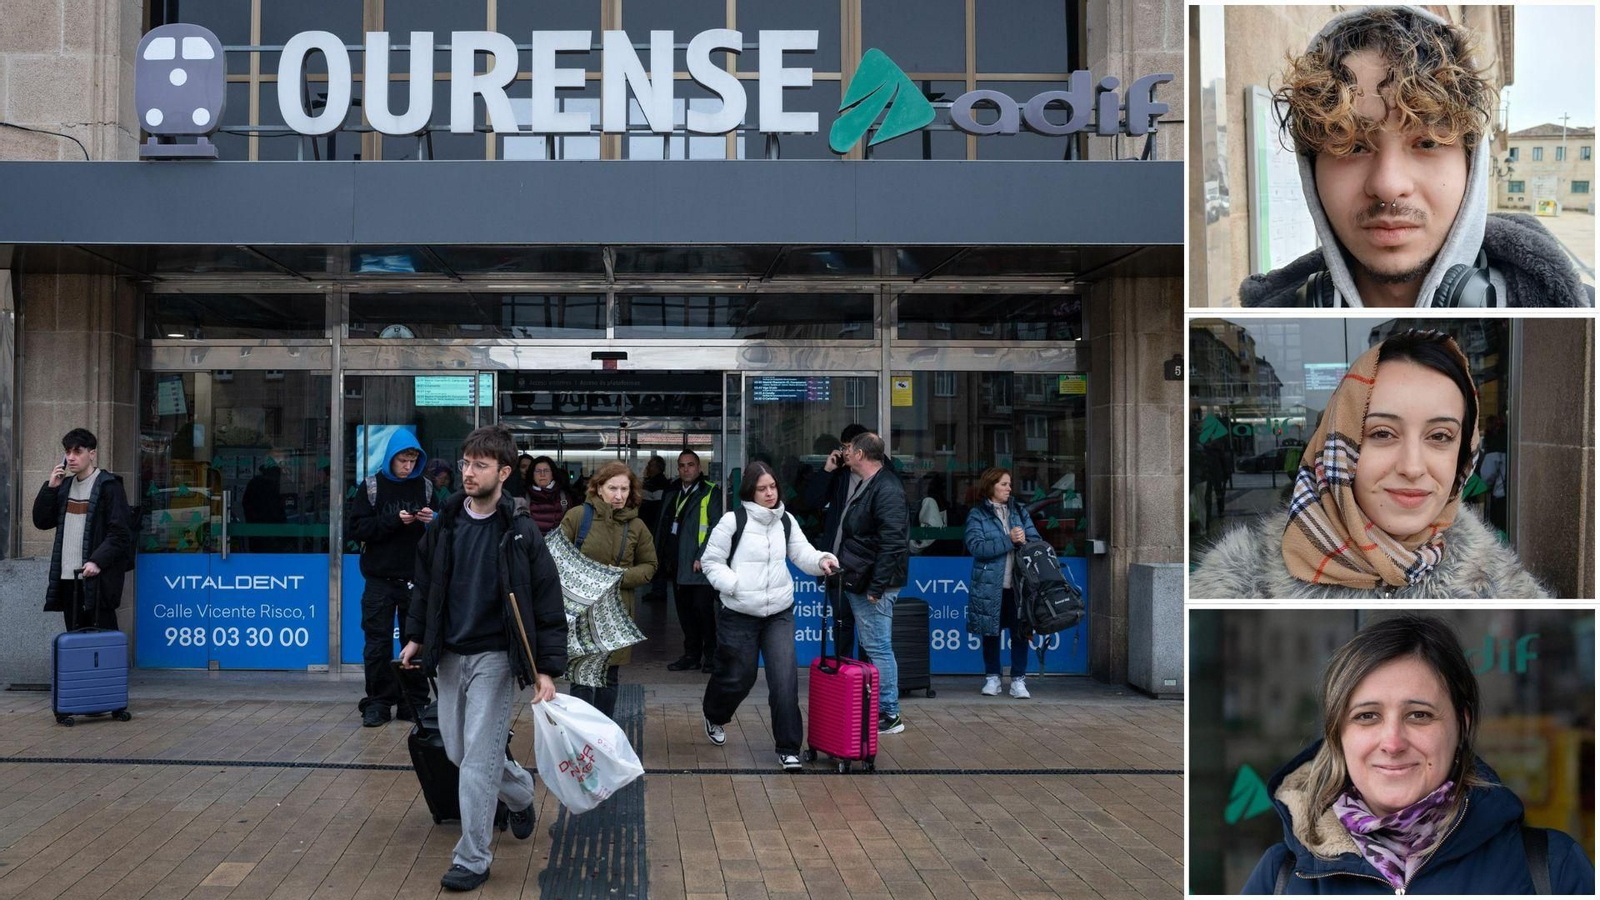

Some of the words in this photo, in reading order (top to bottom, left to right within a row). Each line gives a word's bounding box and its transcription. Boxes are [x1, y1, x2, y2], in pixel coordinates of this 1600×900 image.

[277, 29, 819, 136] OURENSE
[949, 70, 1175, 137] adif
[1174, 365, 1182, 376] 5
[1232, 416, 1294, 437] adif
[164, 575, 305, 590] VITALDENT
[915, 579, 970, 594] VITA
[153, 604, 192, 619] Calle
[196, 604, 256, 619] Vicente
[260, 604, 306, 621] Risco,
[309, 604, 315, 619] 1
[165, 627, 207, 647] 988
[212, 627, 240, 647] 03
[246, 627, 273, 647] 30
[279, 627, 309, 647] 00
[931, 629, 961, 651] 88
[1463, 632, 1542, 676] dif
